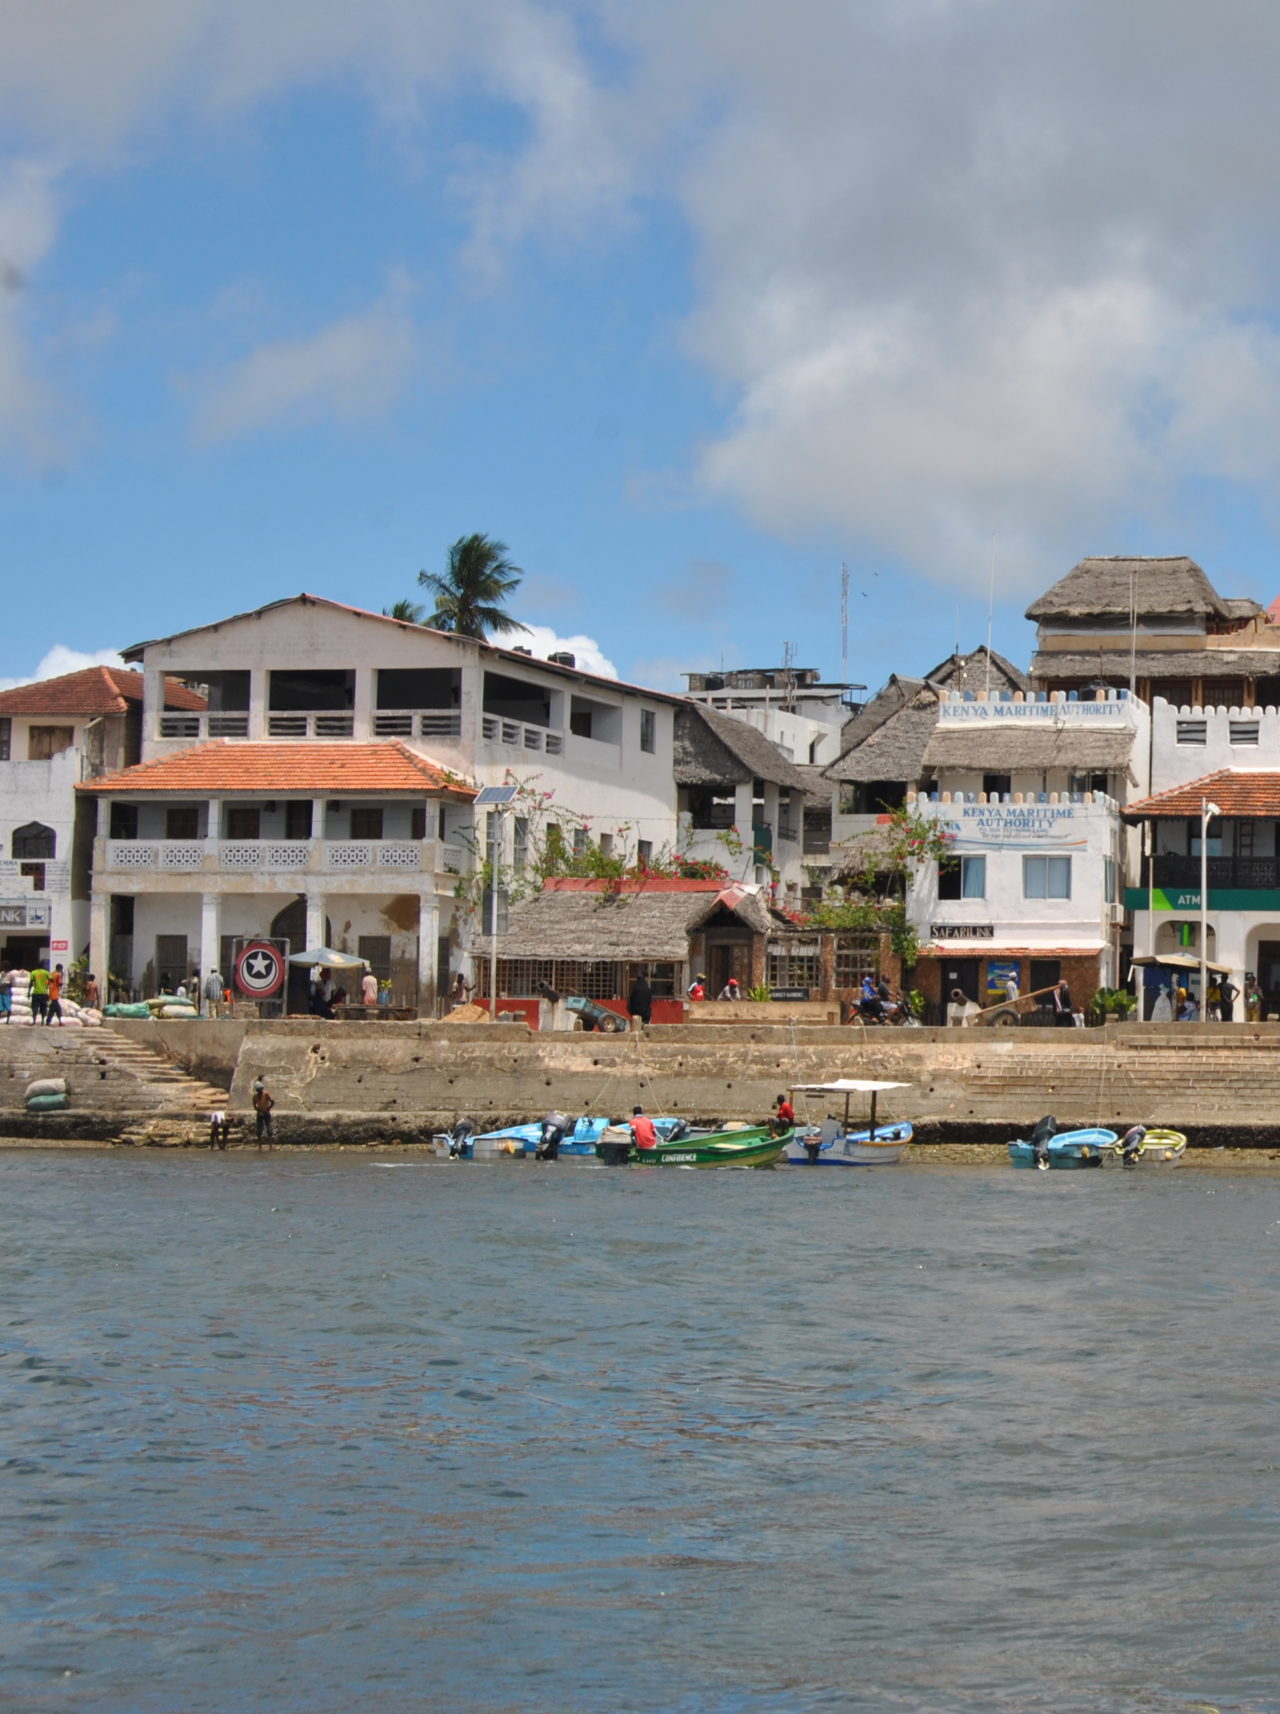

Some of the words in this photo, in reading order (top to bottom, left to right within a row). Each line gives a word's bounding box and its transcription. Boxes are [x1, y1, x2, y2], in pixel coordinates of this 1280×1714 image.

[942, 704, 988, 717] KENYA
[993, 704, 1056, 717] MARITIME
[1058, 703, 1125, 717] AUTHORITY
[962, 807, 1001, 818] KENYA
[1006, 807, 1075, 819] MARITIME
[976, 819, 1055, 828] AUTHORITY
[1177, 894, 1201, 905] ATM
[0, 910, 20, 922] NK
[661, 1153, 697, 1163] CONFIDENCE
